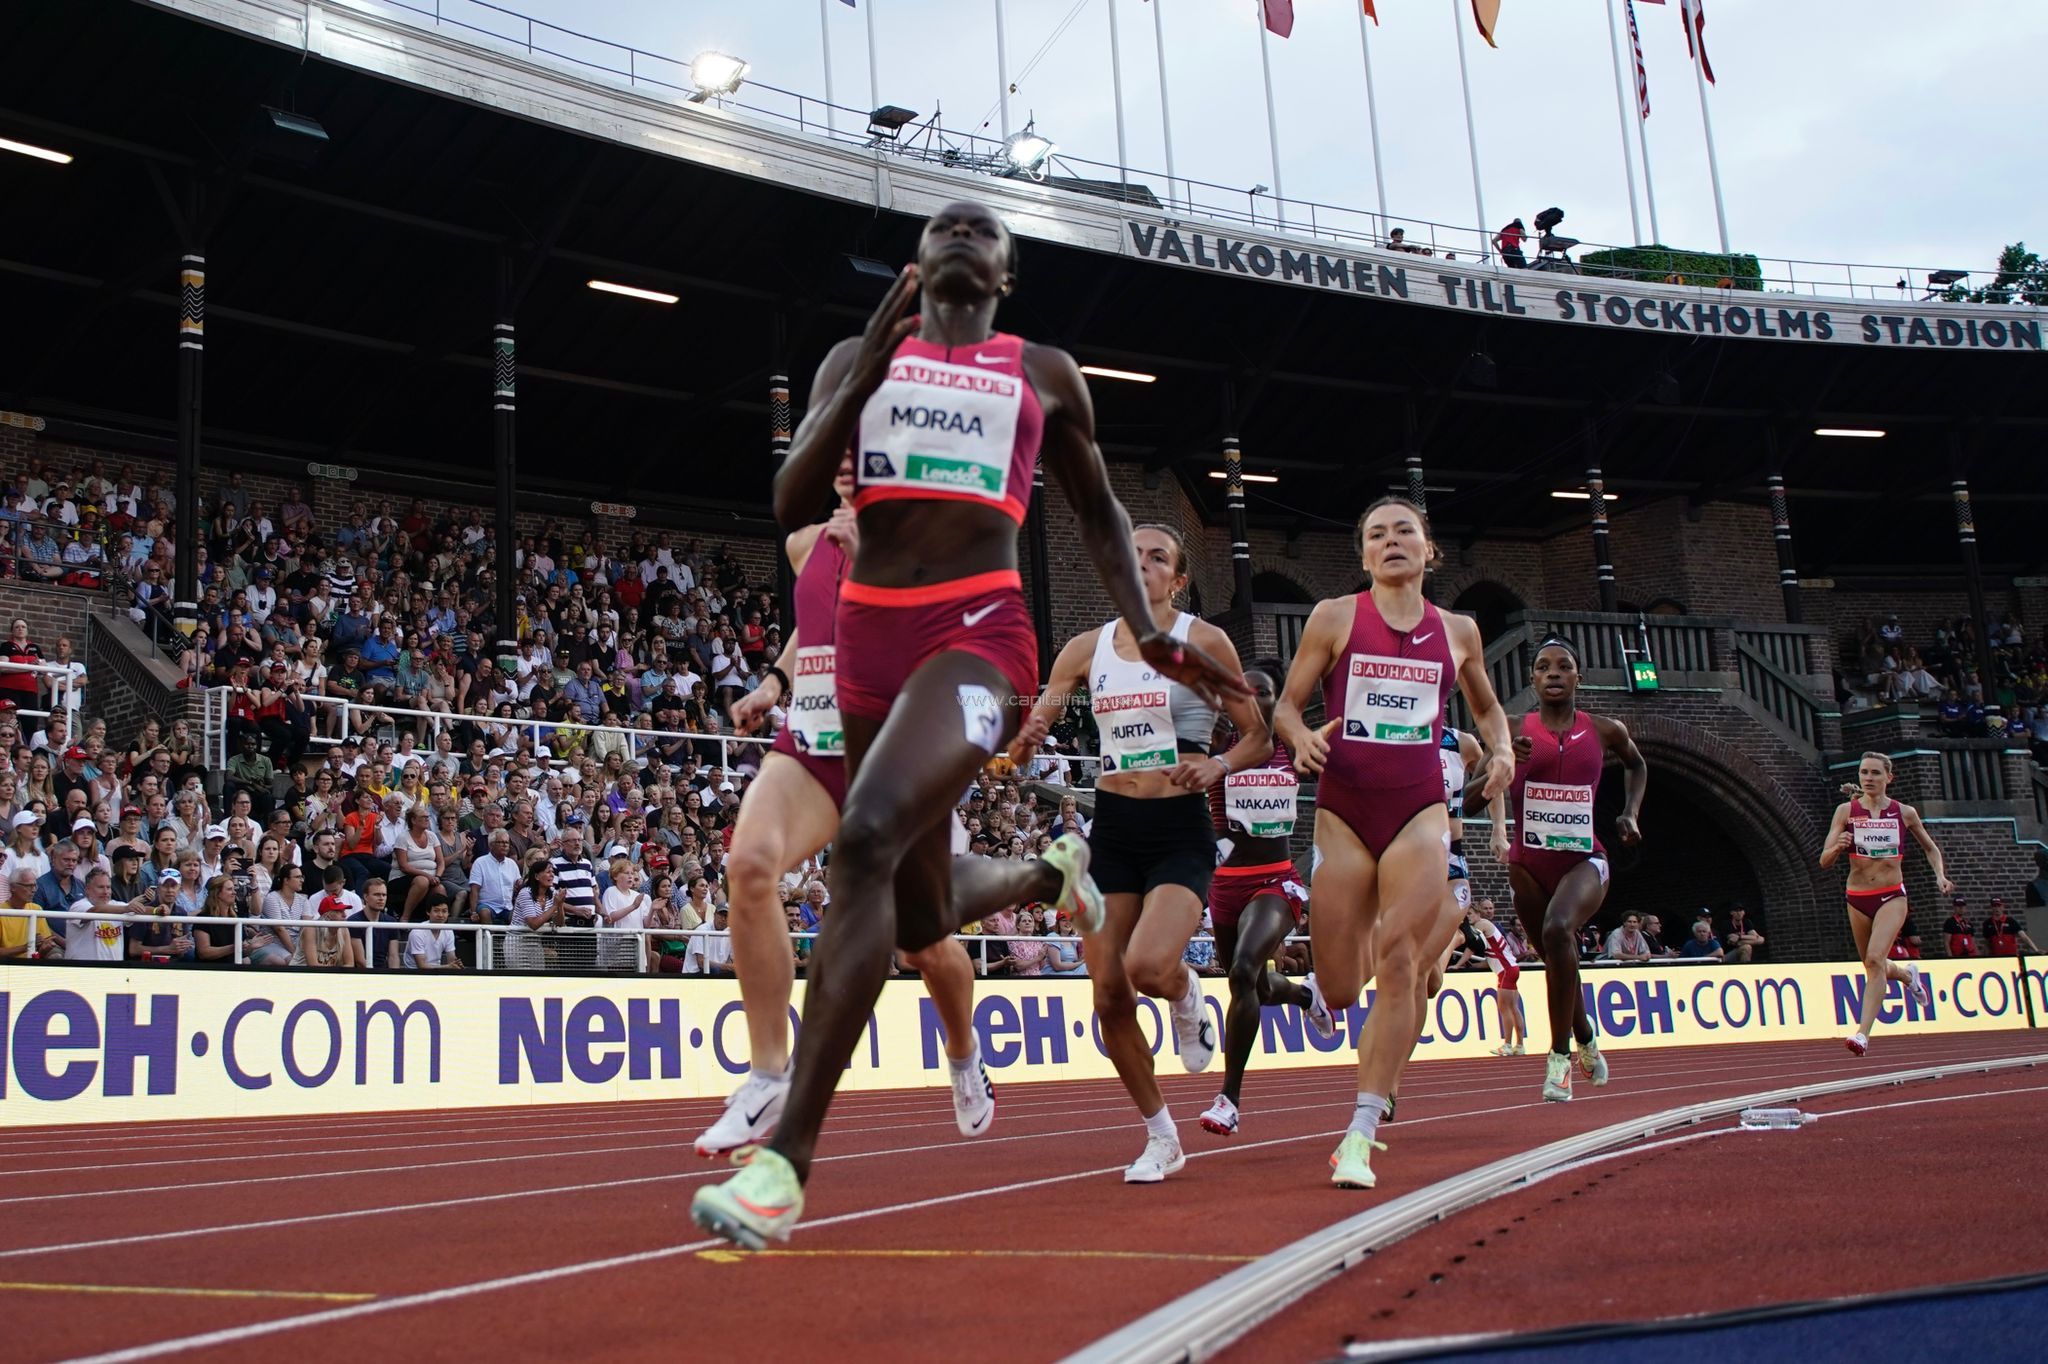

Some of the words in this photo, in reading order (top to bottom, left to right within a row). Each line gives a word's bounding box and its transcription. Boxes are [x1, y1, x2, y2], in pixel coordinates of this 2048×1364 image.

[1128, 218, 1408, 298] VÄLKOMMEN
[1438, 275, 1526, 315] TILL
[1555, 290, 1833, 340] STOCKHOLMS
[1862, 315, 2042, 350] STADION
[891, 406, 984, 437] MORAA
[1353, 661, 1438, 684] BAUHAUS
[1094, 692, 1166, 713] BAUHAUS
[1367, 693, 1418, 710] BISSET
[1111, 723, 1154, 739] HURTA
[1228, 775, 1296, 787] BAUHAUS
[1527, 787, 1589, 802] BAUHAUS
[1235, 799, 1290, 810] NAKAAYI
[1525, 810, 1590, 825] SEKGODISO
